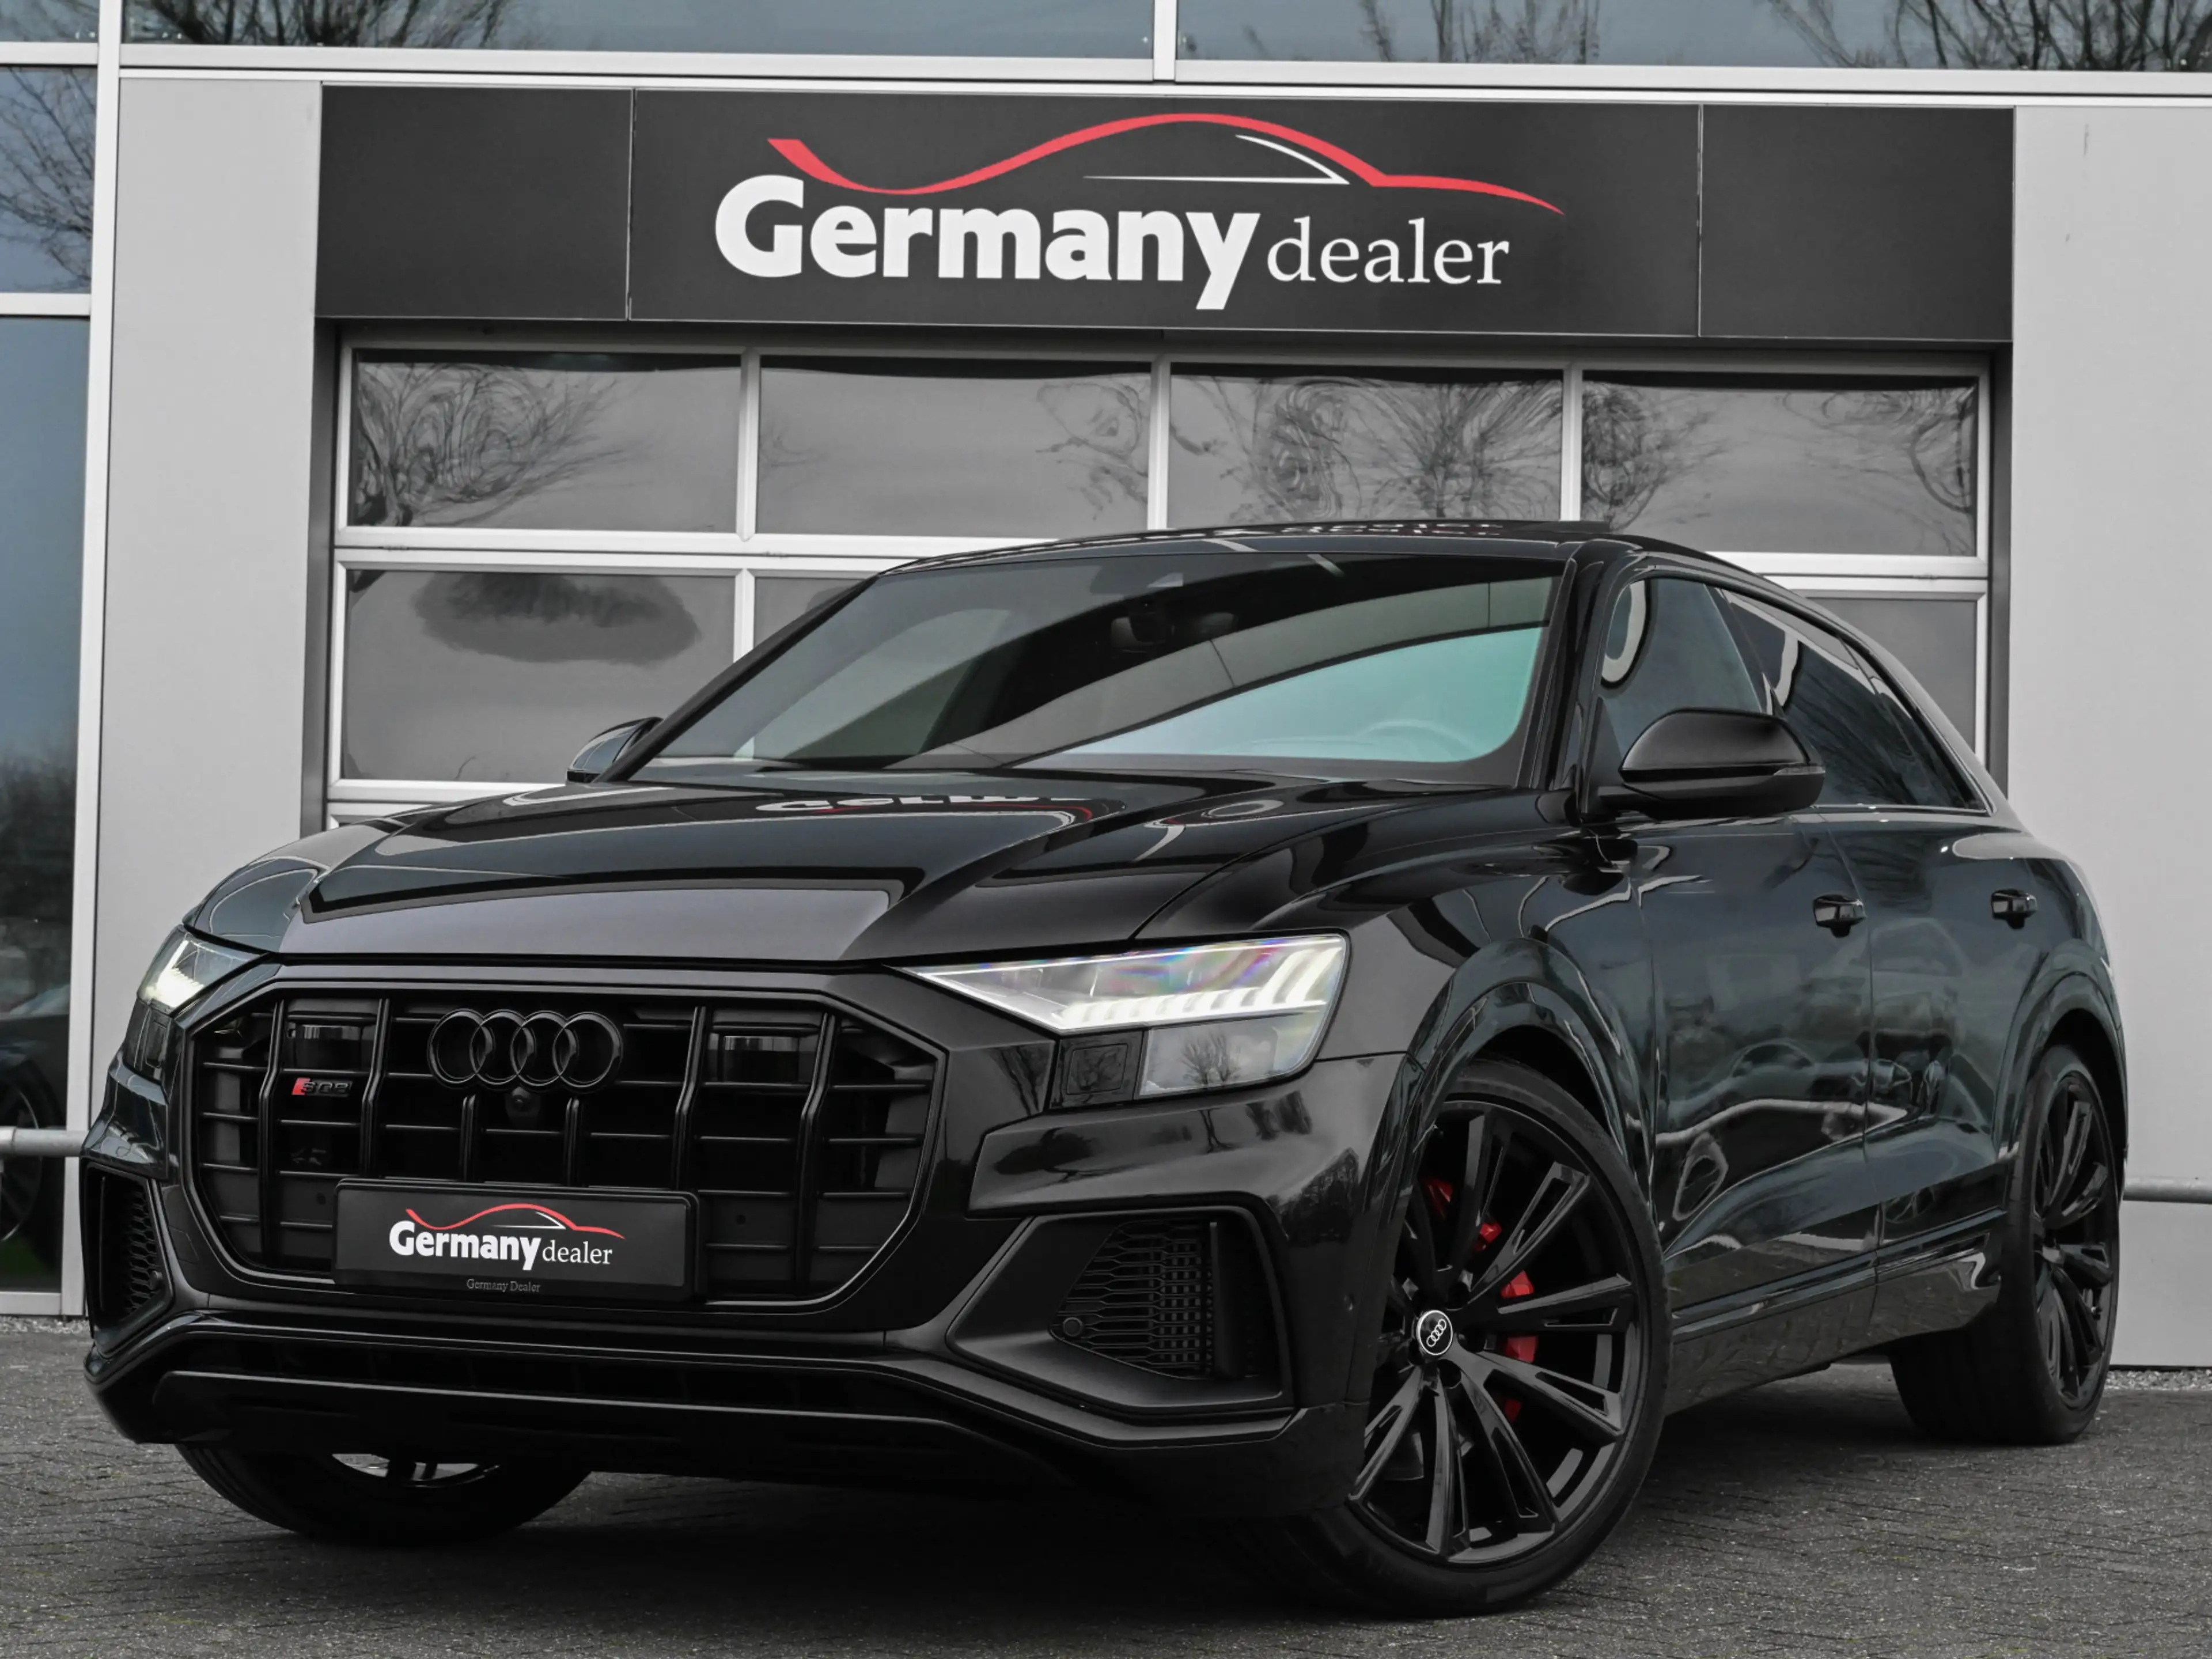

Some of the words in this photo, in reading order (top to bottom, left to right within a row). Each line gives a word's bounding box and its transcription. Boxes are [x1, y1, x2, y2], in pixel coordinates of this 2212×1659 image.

[715, 174, 1261, 311] Germany
[1267, 215, 1510, 285] dealer
[389, 1220, 541, 1271] Germany
[542, 1239, 613, 1265] dealer
[466, 1278, 509, 1293] Germany
[509, 1281, 541, 1293] Dealer
